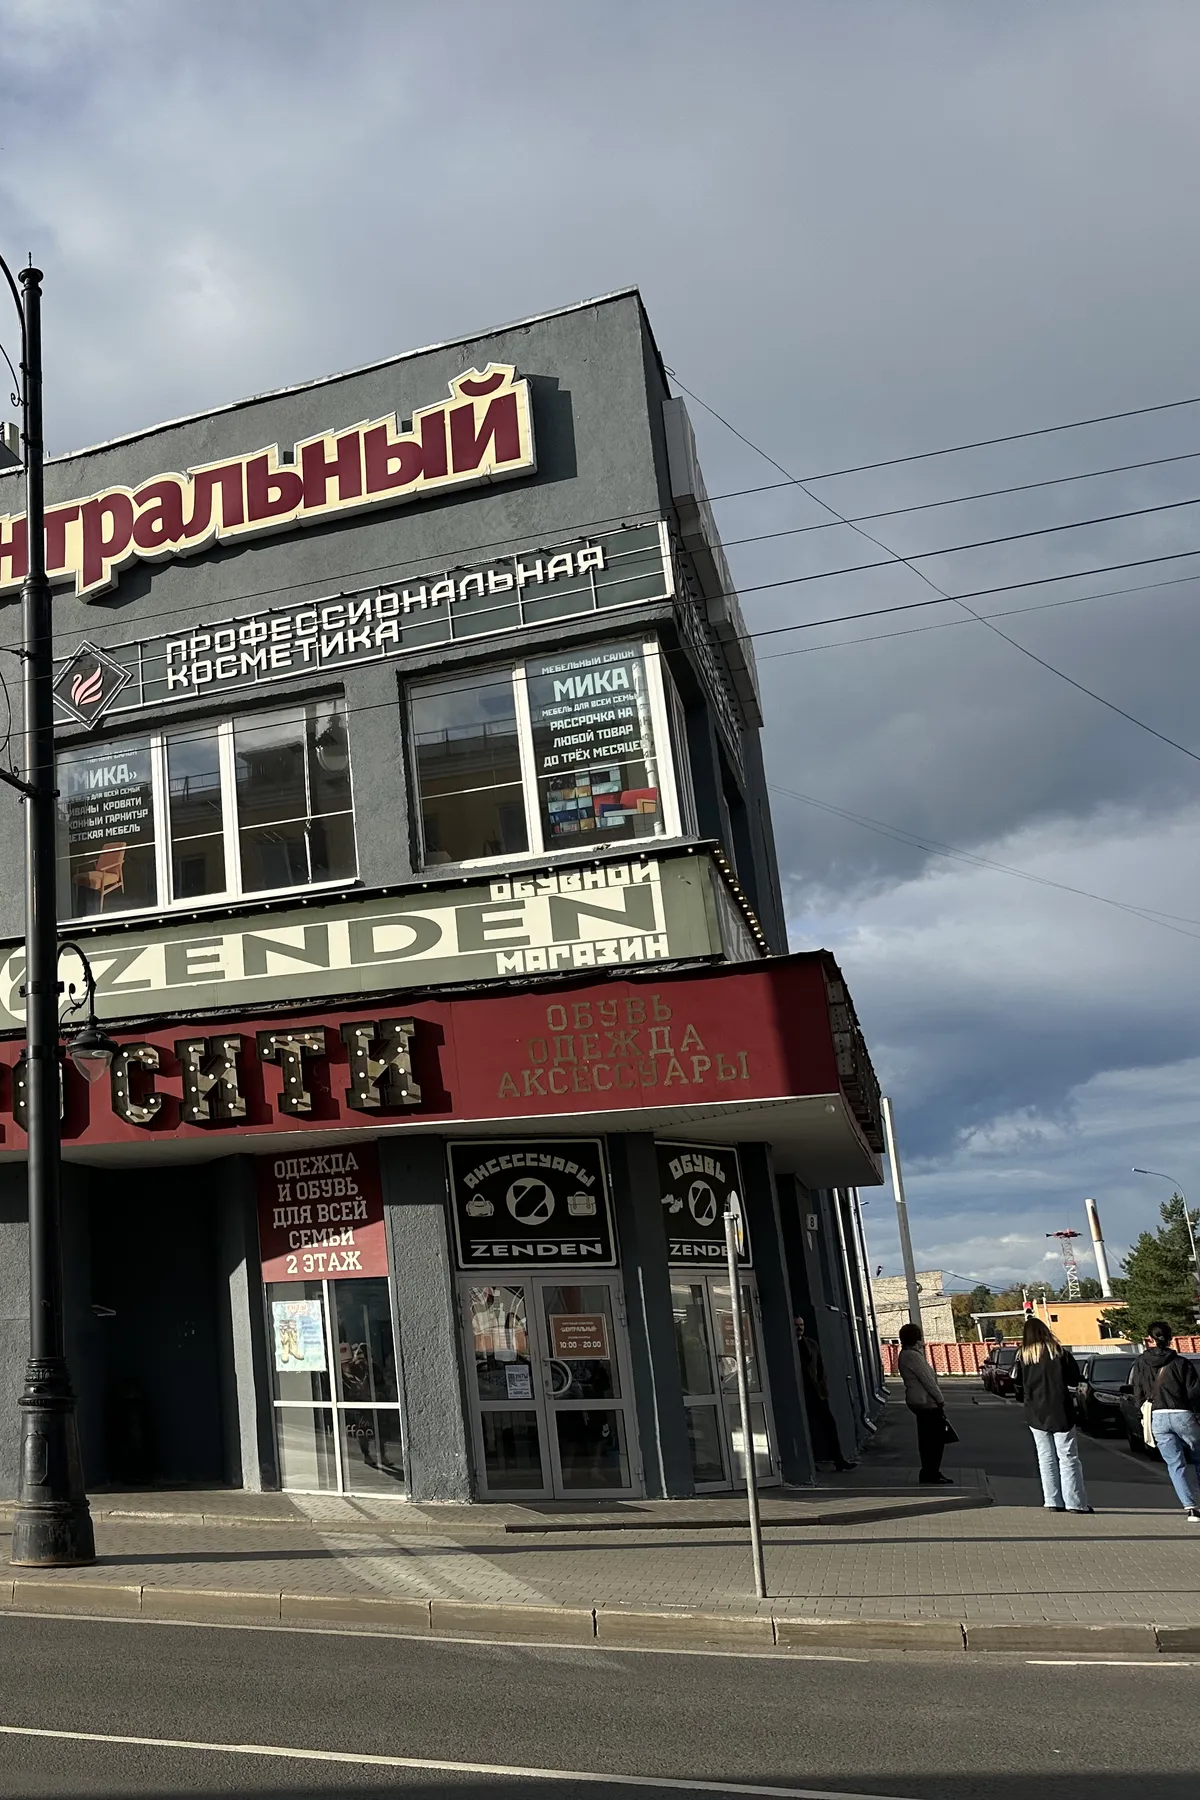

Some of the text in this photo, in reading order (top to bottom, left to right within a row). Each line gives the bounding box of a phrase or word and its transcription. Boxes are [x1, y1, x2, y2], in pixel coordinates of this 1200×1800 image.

[166, 546, 604, 665] ПРОФЕССИОНАЛЬНАЯ
[167, 620, 400, 690] КОСМЕТИКА
[603, 650, 634, 663] САЛОН
[553, 667, 629, 702] МИКА
[542, 705, 573, 717] МЕБЕЛЬ
[574, 702, 590, 712] ДЛЯ
[550, 707, 633, 732] РАССРОЧКА НА
[553, 724, 634, 748] ЛЮБОЙ ТОВАР
[543, 755, 559, 768] ДО
[561, 748, 591, 763] ТРЁХ
[69, 803, 99, 817] ИВАНЫ
[103, 797, 142, 811] КРОВАТИ
[105, 808, 149, 824] ГАРНИТУР
[105, 823, 141, 837] МЕБЕЛЬ
[81, 883, 657, 995] ZENDEN
[496, 933, 670, 976] МАГАЗИН
[546, 994, 673, 1032] ОБУВЬ
[528, 1024, 707, 1066] ОДЕЖДА
[110, 1016, 422, 1125] СИТИ
[497, 1051, 751, 1098] АКСЕССУАРЫ
[274, 1152, 359, 1180] ОДЕЖДА
[463, 1152, 596, 1189] АКСЕССУАРЫ
[668, 1153, 726, 1183] ОБУВЬ
[277, 1176, 359, 1202] И ОБУВЬ
[273, 1196, 368, 1229] ДЛЯ ВСЕЙ
[288, 1226, 355, 1249] СЕМЬИ
[470, 1243, 603, 1257] ZENDEN
[669, 1243, 745, 1257] ZENDE
[286, 1250, 363, 1274] 2 ЭТАЖ
